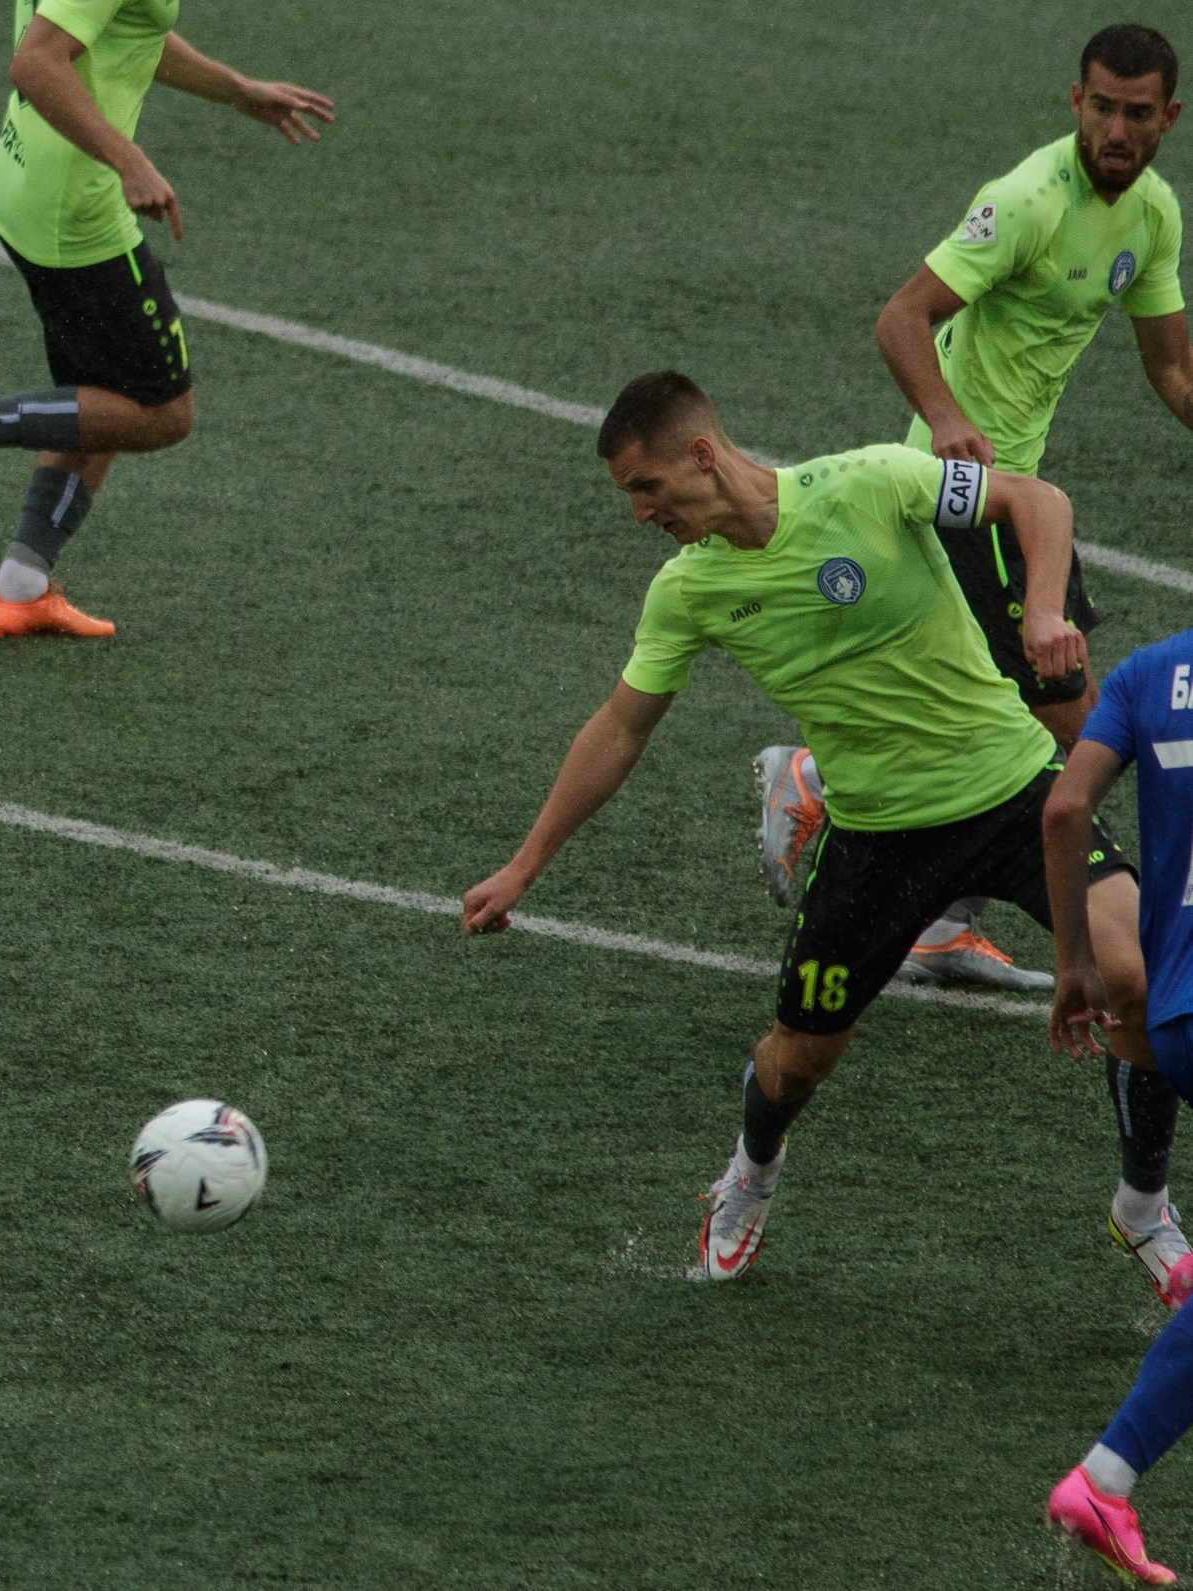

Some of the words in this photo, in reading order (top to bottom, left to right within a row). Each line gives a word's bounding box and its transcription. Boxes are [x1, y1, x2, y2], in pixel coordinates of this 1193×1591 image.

[948, 462, 974, 517] CAPT
[730, 601, 762, 623] JAKO
[1170, 663, 1193, 711] Б
[797, 959, 850, 1013] 18
